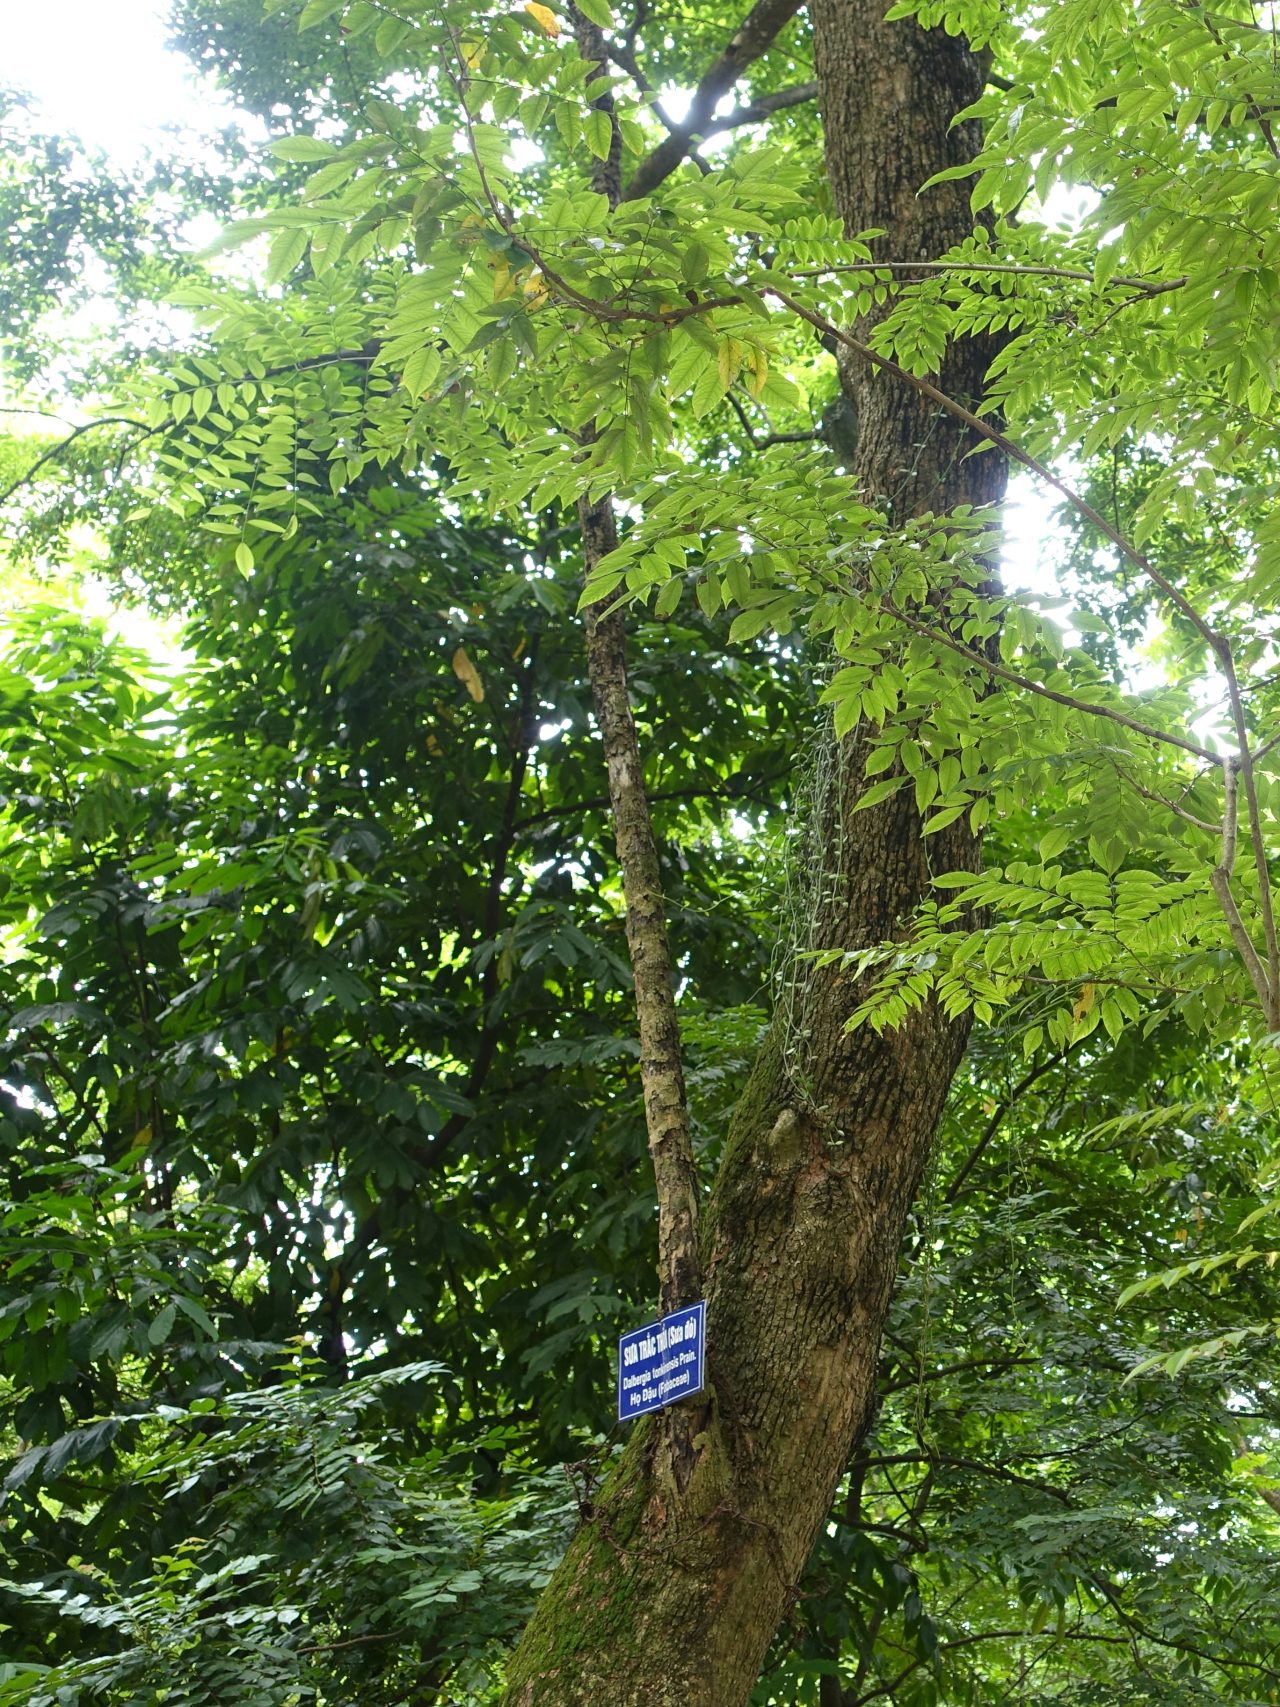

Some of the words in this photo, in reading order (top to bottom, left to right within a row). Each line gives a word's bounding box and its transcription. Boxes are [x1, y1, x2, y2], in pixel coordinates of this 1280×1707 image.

[624, 1342, 639, 1367] SƯA
[623, 1369, 651, 1390] Dalbergia
[679, 1349, 697, 1367] Prain.
[630, 1391, 641, 1407] Họ
[642, 1386, 657, 1403] Đậu
